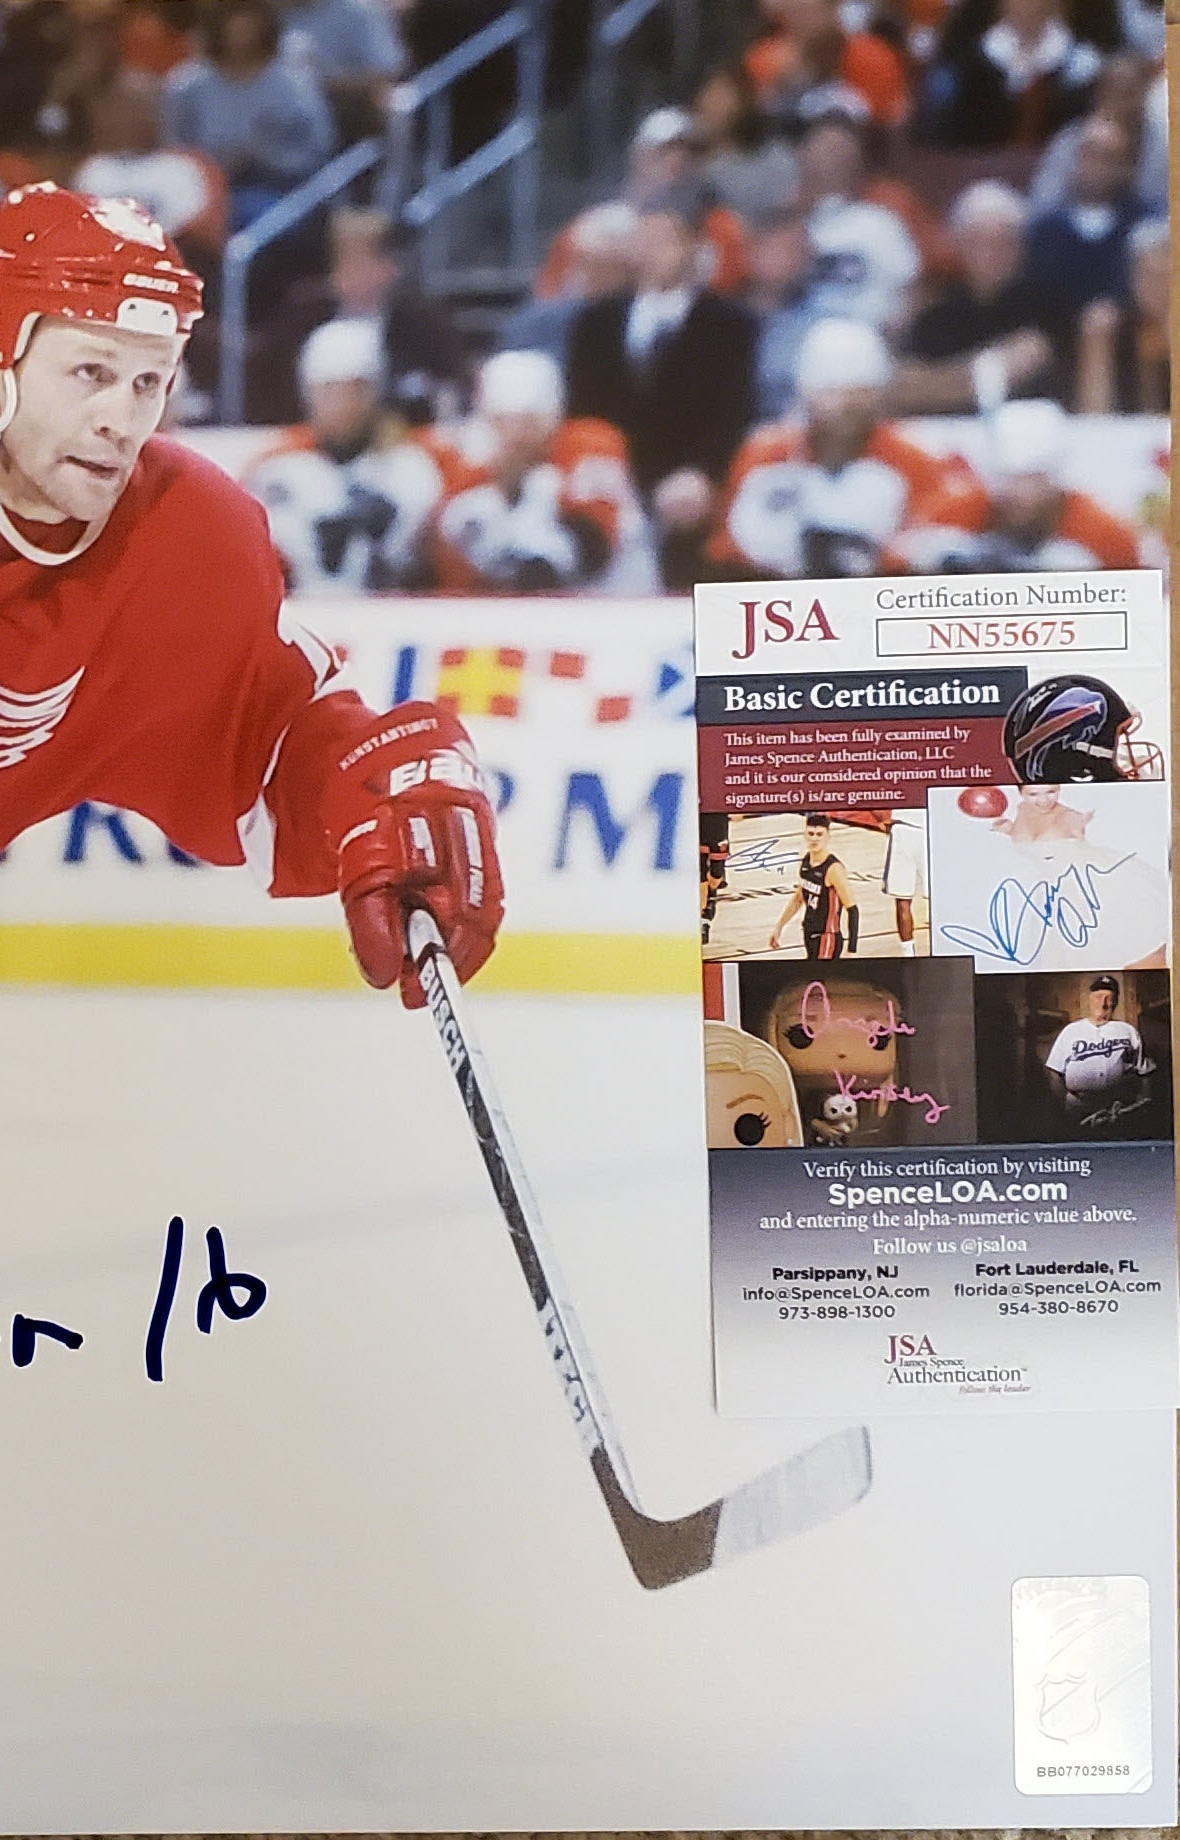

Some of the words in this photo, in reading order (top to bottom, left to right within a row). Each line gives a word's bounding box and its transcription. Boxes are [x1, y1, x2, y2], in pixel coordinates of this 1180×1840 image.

[876, 587, 1019, 610] Certification
[1026, 583, 1127, 606] Number:
[732, 599, 841, 660] JSA
[927, 620, 1076, 649] NN55675
[724, 685, 803, 712] Basic
[810, 679, 1000, 709] Certification
[724, 732, 752, 747] This
[756, 731, 786, 746] item
[790, 730, 813, 744] has
[816, 729, 847, 743] been
[852, 728, 881, 746] fully
[885, 727, 950, 742] examined
[953, 726, 971, 743] by
[724, 753, 763, 767] James
[767, 751, 814, 768] Spence
[818, 748, 922, 763] Authentication,
[925, 746, 955, 760] LLC
[724, 771, 750, 785] and
[754, 770, 763, 783] it
[767, 770, 778, 783] is
[781, 772, 804, 783] our
[808, 768, 880, 782] considered
[884, 767, 937, 783] opinion
[940, 766, 966, 779] that
[970, 765, 992, 778] the
[726, 791, 804, 808] signature(s)
[808, 789, 845, 803] is/are
[848, 788, 906, 807] genuine.
[803, 1161, 855, 1181] Verify
[860, 1160, 893, 1177] this
[896, 1158, 998, 1176] certification
[1002, 1157, 1025, 1178] by
[1027, 1156, 1091, 1177] visiting
[828, 1180, 1067, 1208] SpenceLOA.com
[759, 1213, 792, 1229] and
[796, 1212, 869, 1232] entering
[872, 1211, 900, 1228] the
[904, 1209, 1030, 1230] alpha-numeric
[1033, 1207, 1078, 1224] value
[1082, 1206, 1138, 1223] above.
[872, 1237, 932, 1255] Follow
[936, 1240, 957, 1254] us
[961, 1236, 1027, 1257] @jsaloa
[772, 1266, 871, 1284] Parsippany,
[876, 1266, 899, 1279] NJ
[975, 1262, 1012, 1277] Fort
[1016, 1260, 1114, 1277] Lauderdale,
[1118, 1260, 1139, 1274] FL
[742, 1285, 930, 1303] info@SpenceLOA.com
[954, 1280, 1161, 1299] florida@SpenceLOA.com
[778, 1305, 895, 1320] 973-898-1300
[998, 1299, 1119, 1316] 954-380-8670
[884, 1334, 937, 1364] JSA
[930, 1357, 964, 1369] Spence
[1037, 1766, 1130, 1777] BB077029858
